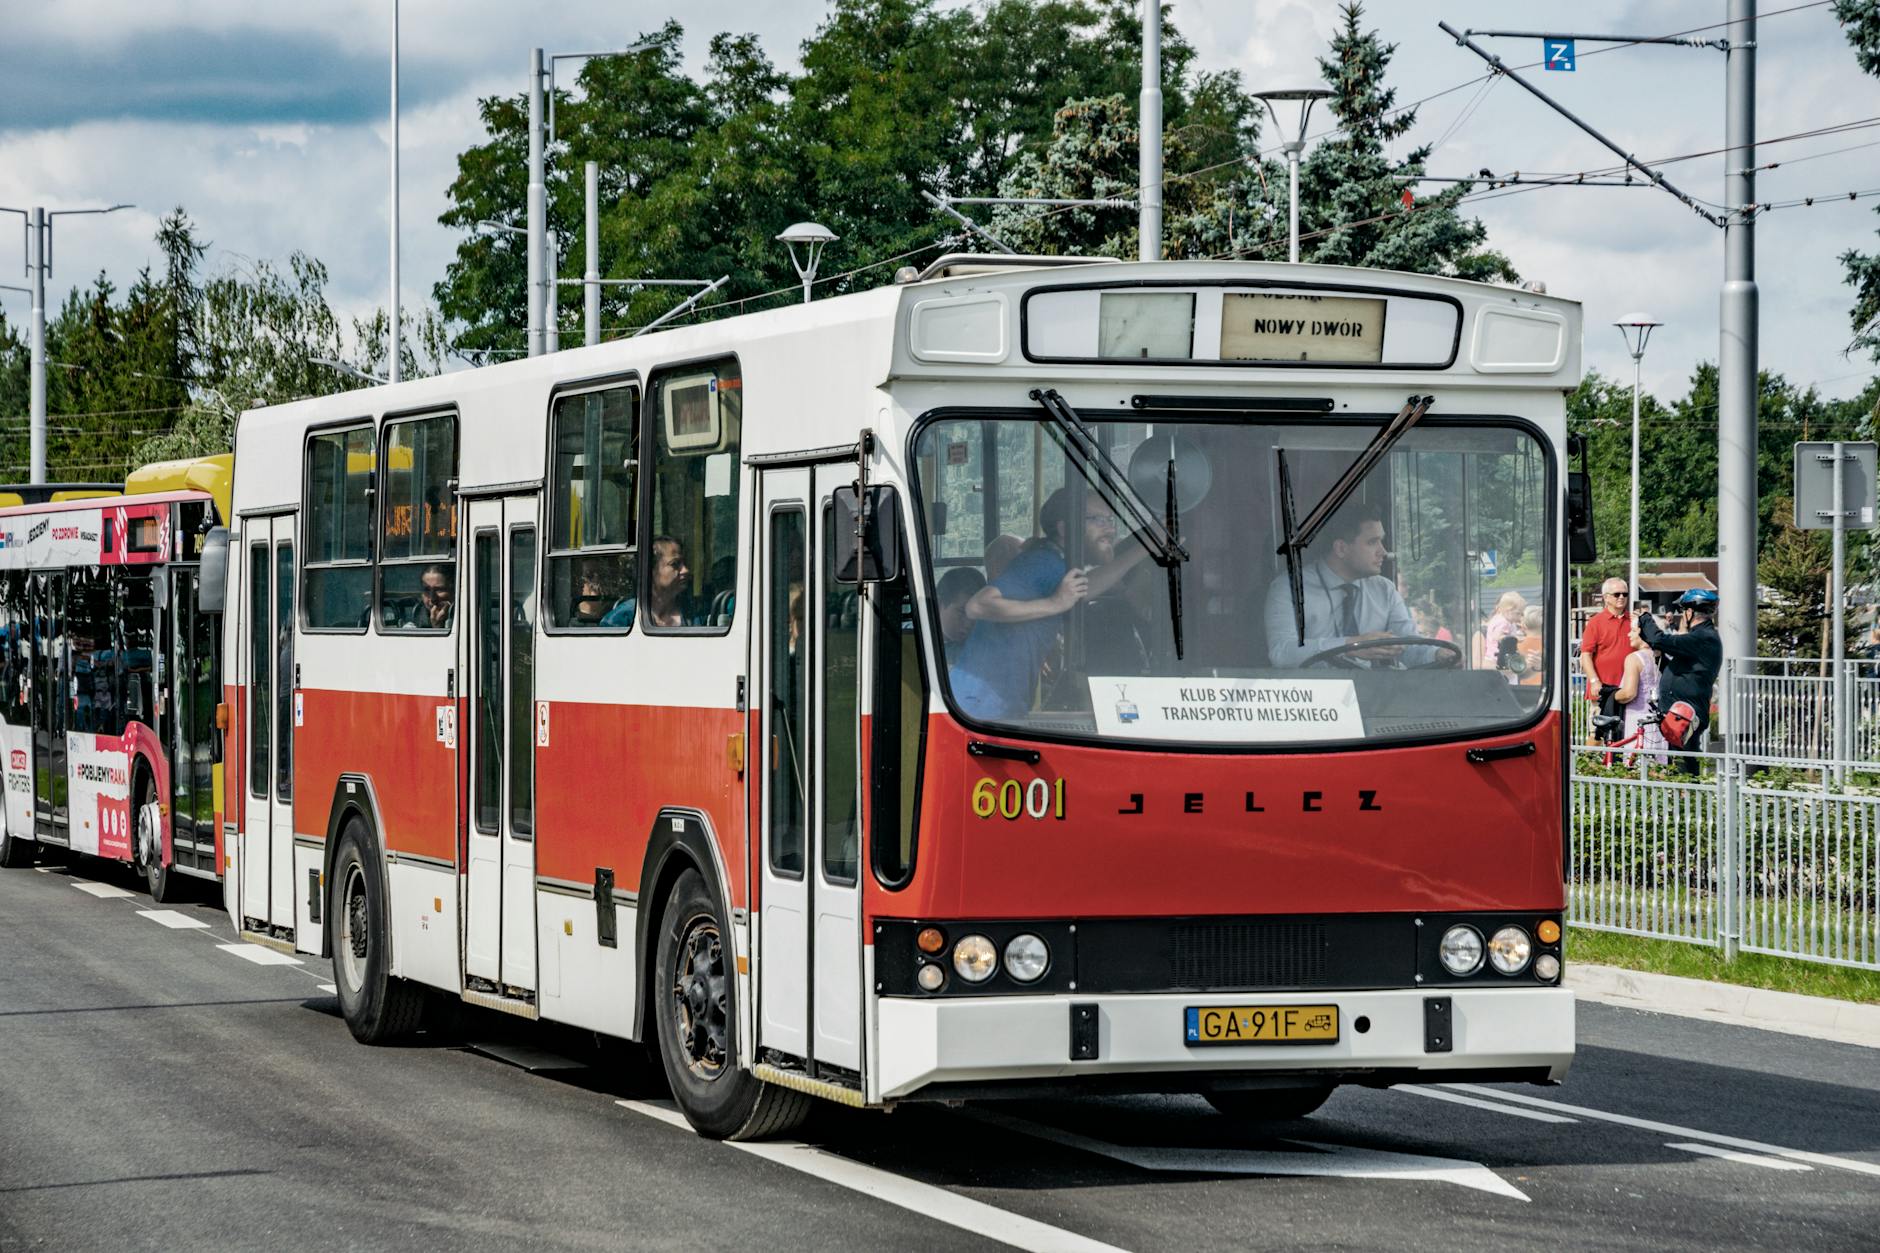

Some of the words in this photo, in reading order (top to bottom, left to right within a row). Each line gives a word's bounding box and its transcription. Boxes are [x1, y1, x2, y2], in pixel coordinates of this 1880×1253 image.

[1254, 318, 1305, 335] NOWY
[1180, 688, 1216, 702] KLUB
[1220, 687, 1313, 703] SYMPATYKÓW
[1161, 706, 1253, 721] TRANSPORTU
[1257, 708, 1338, 722] MIEJSKIEGO
[971, 777, 1065, 820] 6001
[1118, 790, 1382, 814] JELCZ
[1204, 1010, 1241, 1038] GA
[1252, 1009, 1299, 1038] 91F
